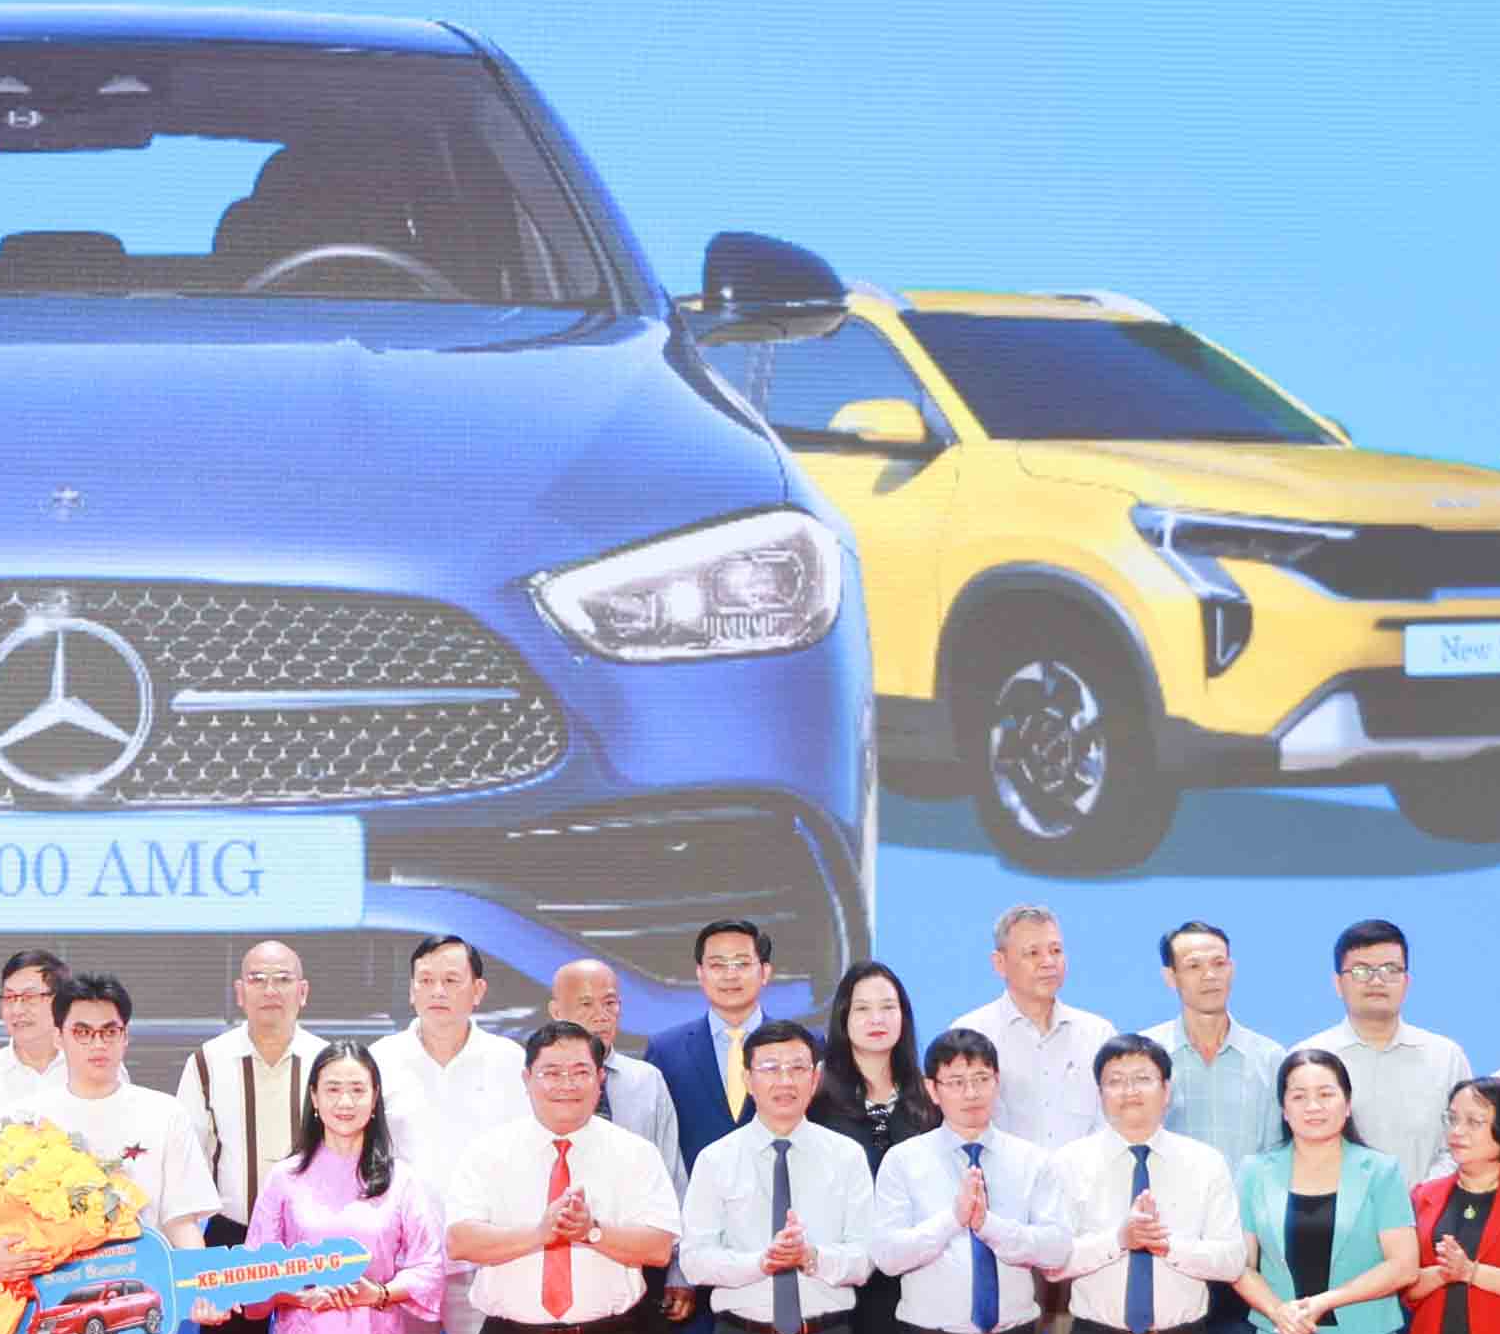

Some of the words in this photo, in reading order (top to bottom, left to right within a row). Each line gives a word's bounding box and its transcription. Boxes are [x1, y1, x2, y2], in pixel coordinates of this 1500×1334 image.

[88, 839, 265, 898] AMG
[197, 1271, 217, 1288] XE
[224, 1264, 279, 1284] HONDA
[283, 1256, 325, 1276] HR-V
[328, 1253, 341, 1269] G
